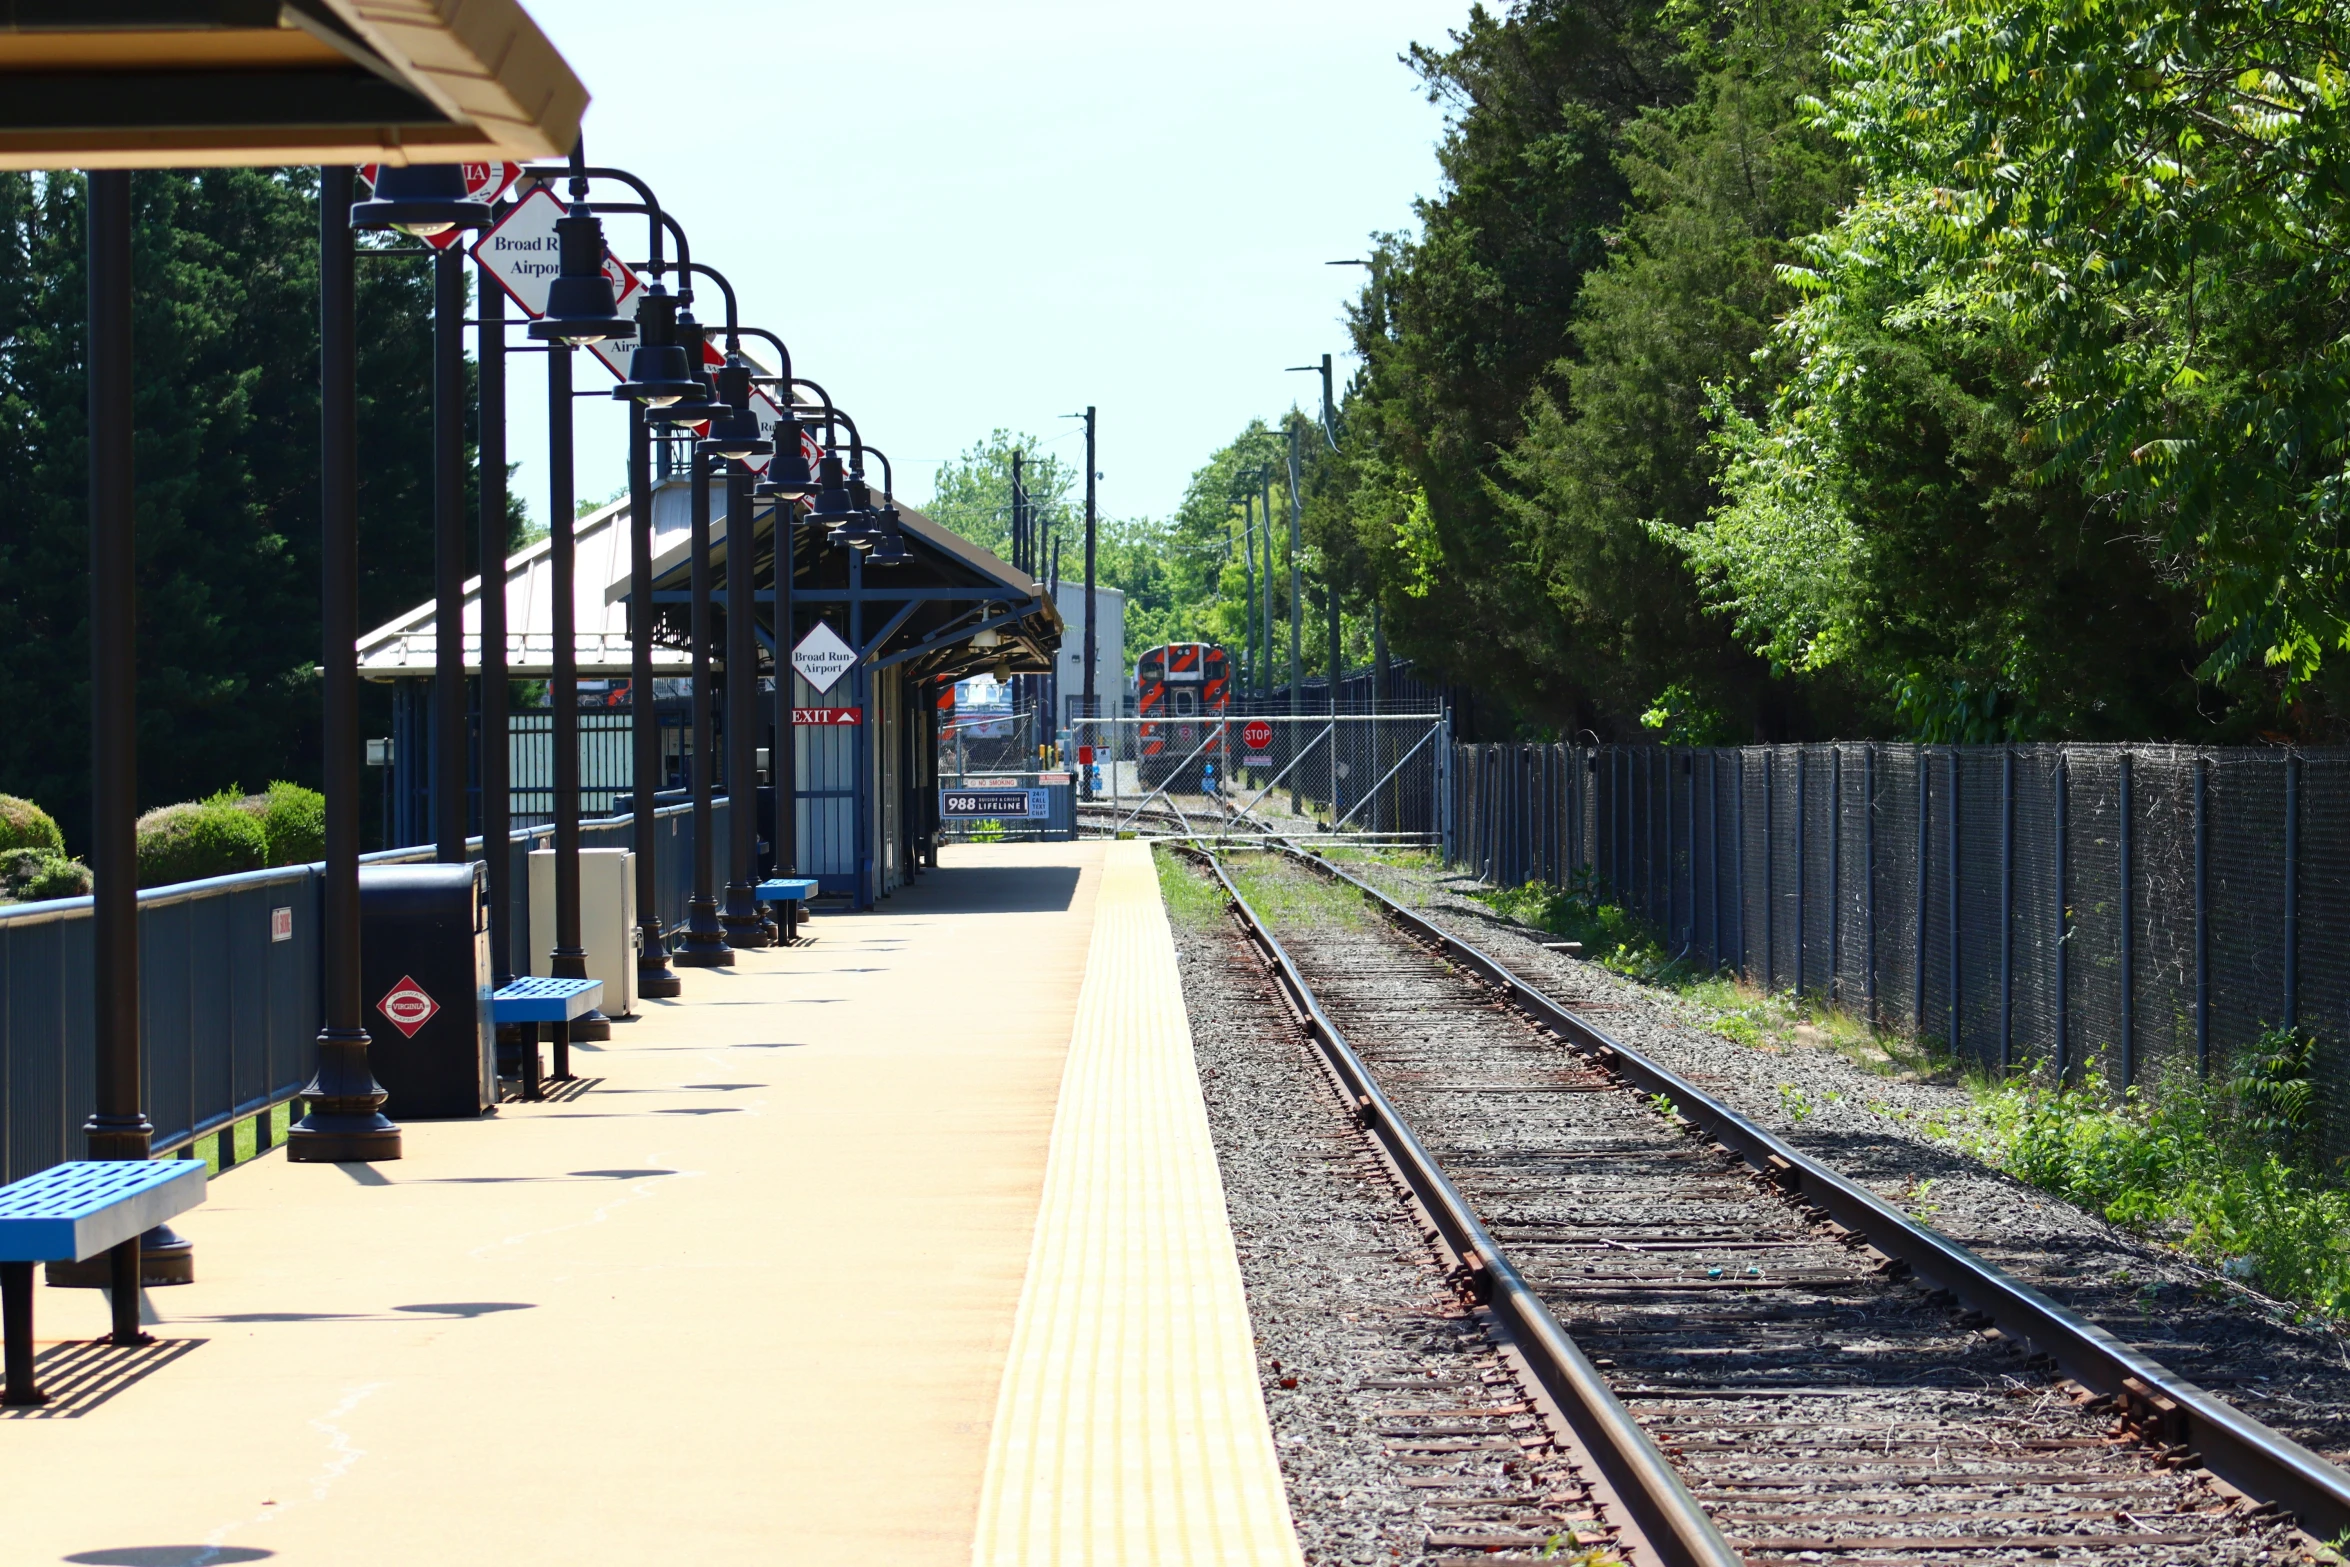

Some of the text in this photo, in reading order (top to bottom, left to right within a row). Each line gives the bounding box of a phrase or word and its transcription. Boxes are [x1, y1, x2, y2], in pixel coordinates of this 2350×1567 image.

[495, 236, 542, 251] Broad
[510, 260, 560, 278] Airpor
[795, 652, 825, 661] Broad
[804, 664, 842, 675] Airport
[792, 710, 831, 723] EXIT
[1245, 729, 1270, 740] STOP
[948, 798, 976, 810] 988
[978, 802, 1021, 810] LIFELINE
